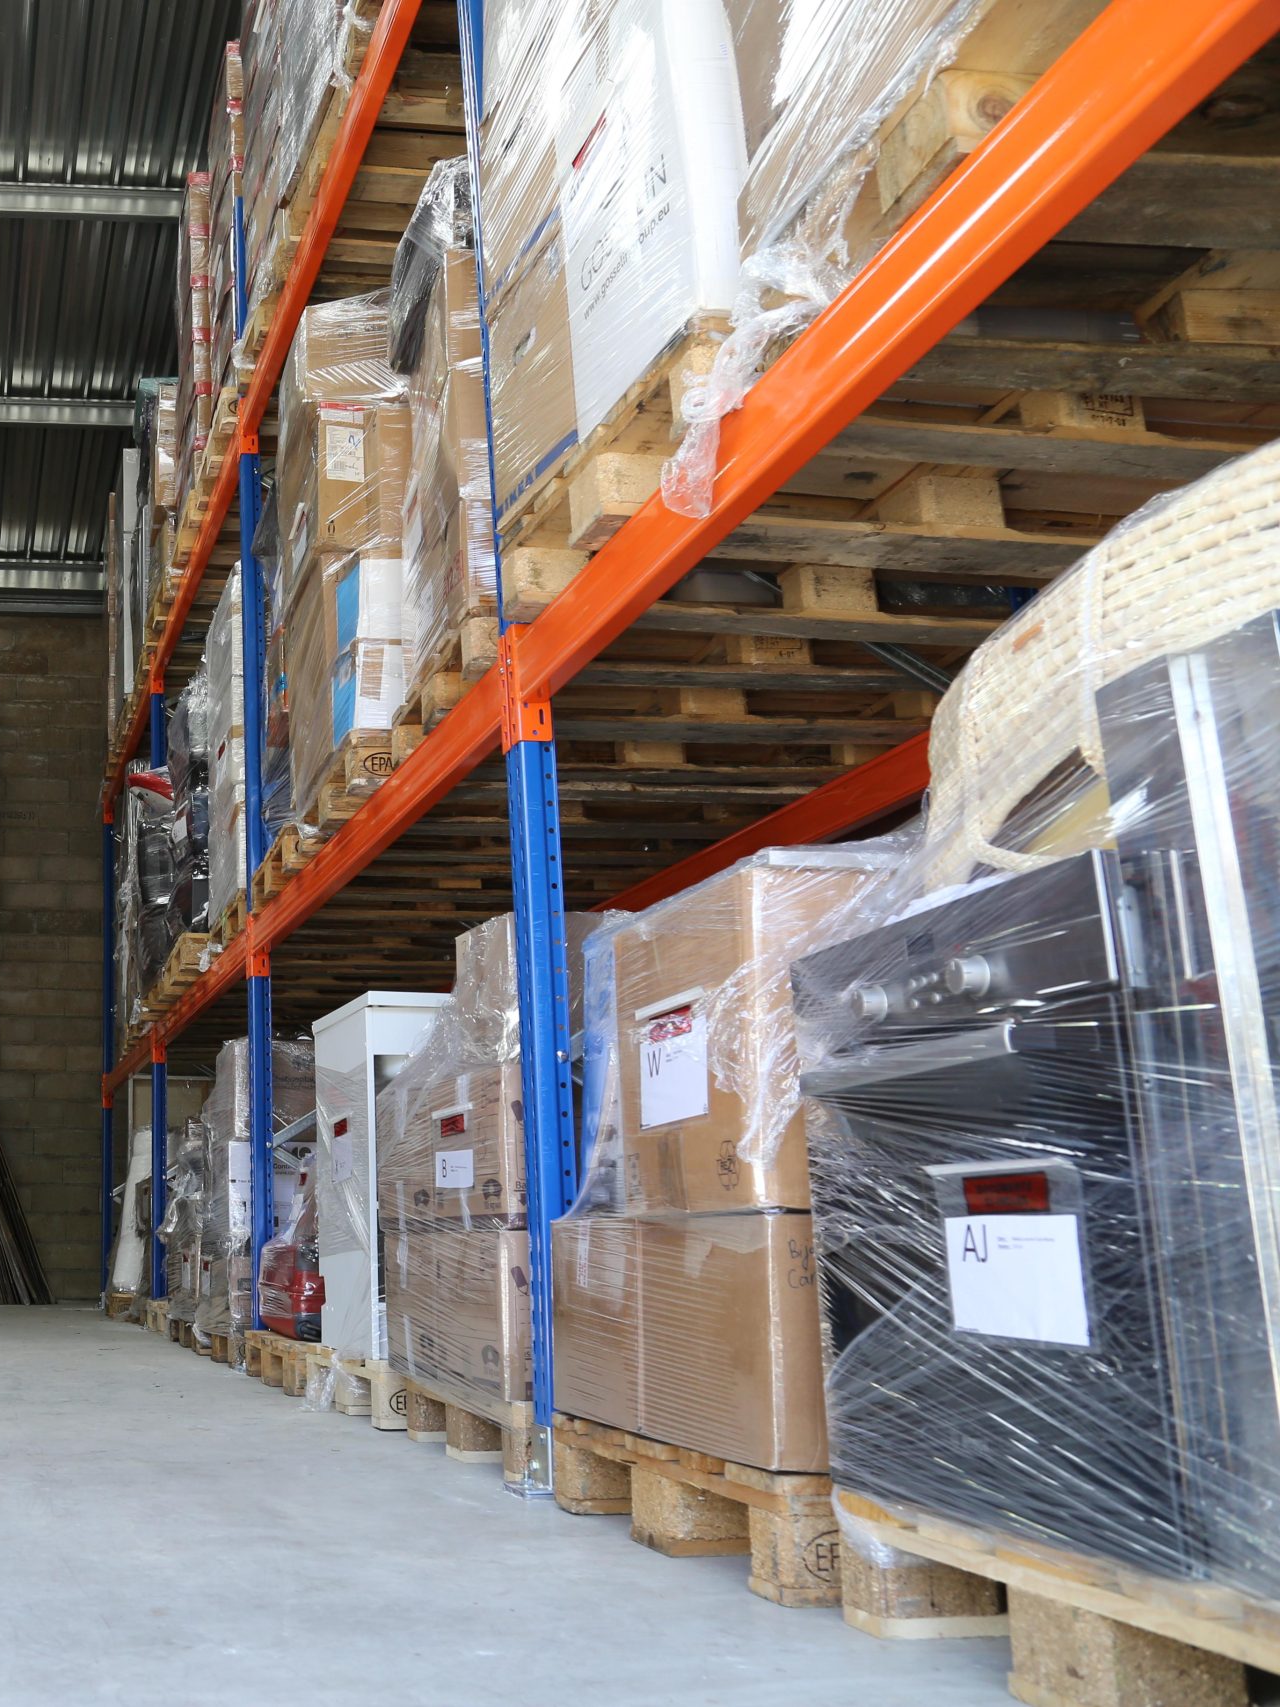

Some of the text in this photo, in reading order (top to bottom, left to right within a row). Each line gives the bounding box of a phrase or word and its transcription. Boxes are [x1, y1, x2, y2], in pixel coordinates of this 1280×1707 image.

[371, 757, 392, 772] EPA
[647, 1047, 662, 1078] W
[441, 1158, 448, 1178] B
[962, 1223, 988, 1263] AJ
